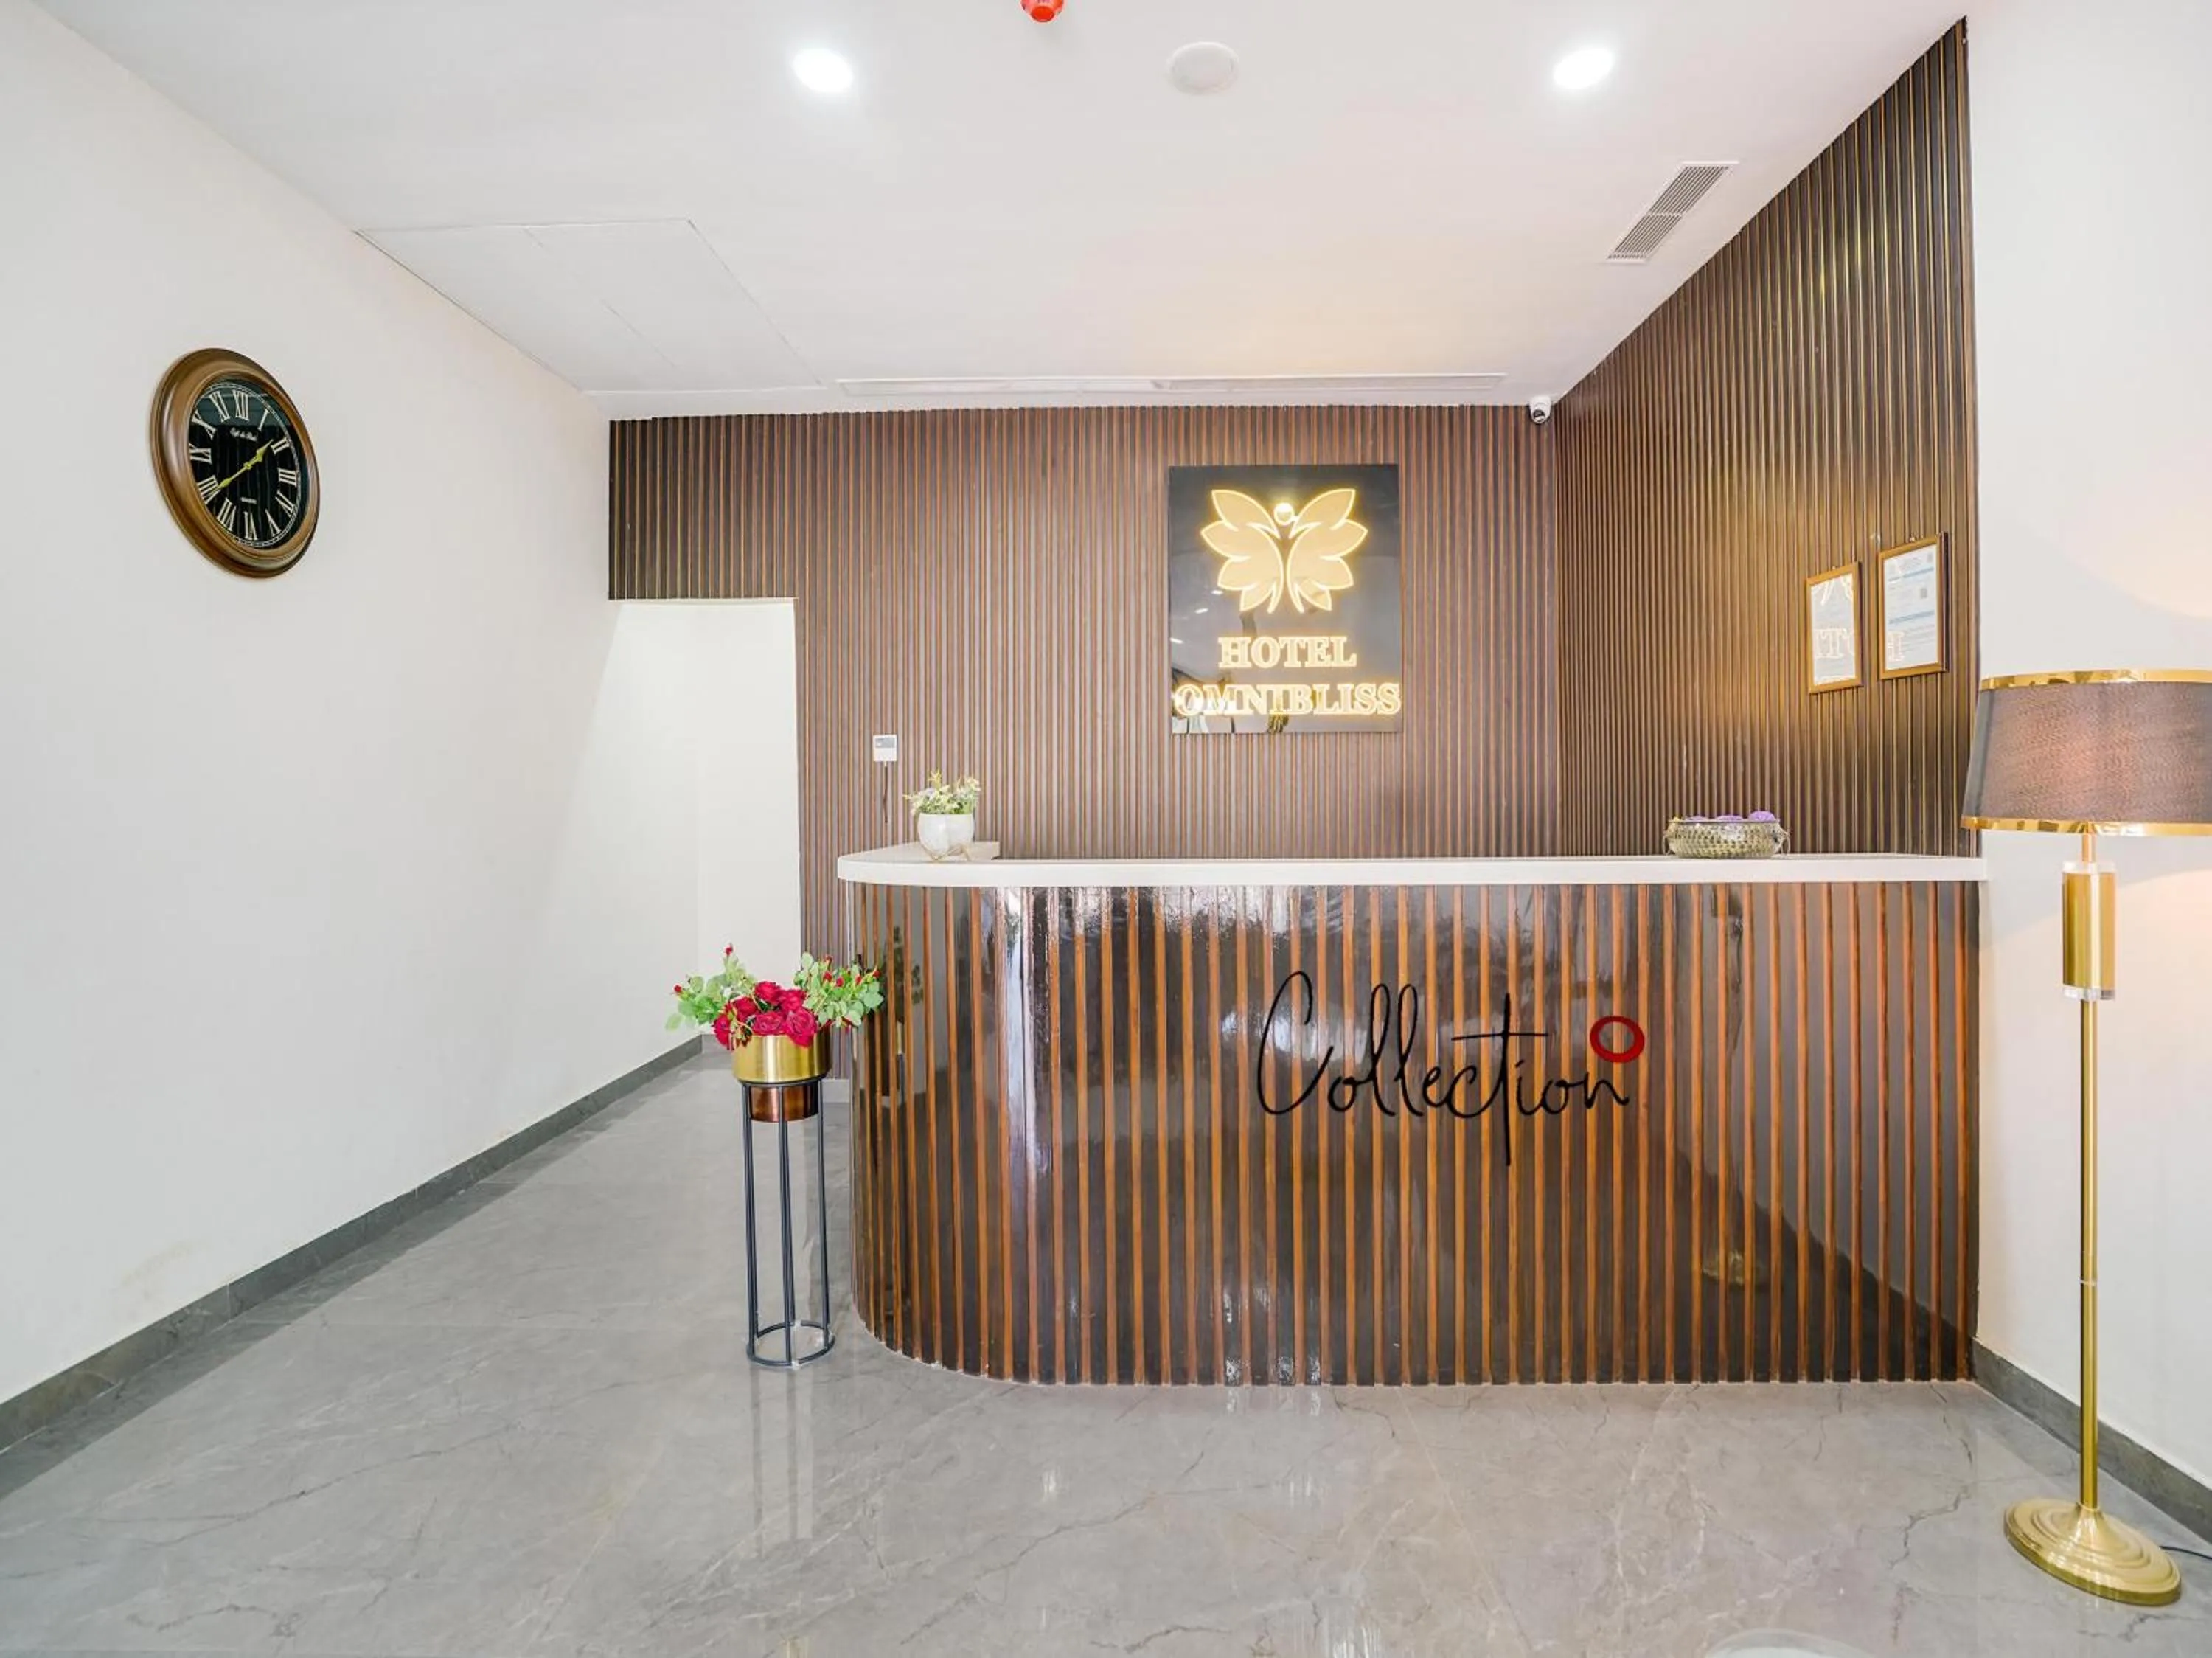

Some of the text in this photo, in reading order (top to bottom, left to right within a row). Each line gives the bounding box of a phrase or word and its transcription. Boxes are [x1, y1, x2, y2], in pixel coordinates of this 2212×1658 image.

[209, 391, 230, 423] XI
[232, 389, 250, 421] XII
[192, 410, 217, 440] X
[1217, 636, 1357, 668] HOTEL
[1173, 683, 1402, 715] OMNIBLISS
[1257, 971, 1630, 1166] Collection
